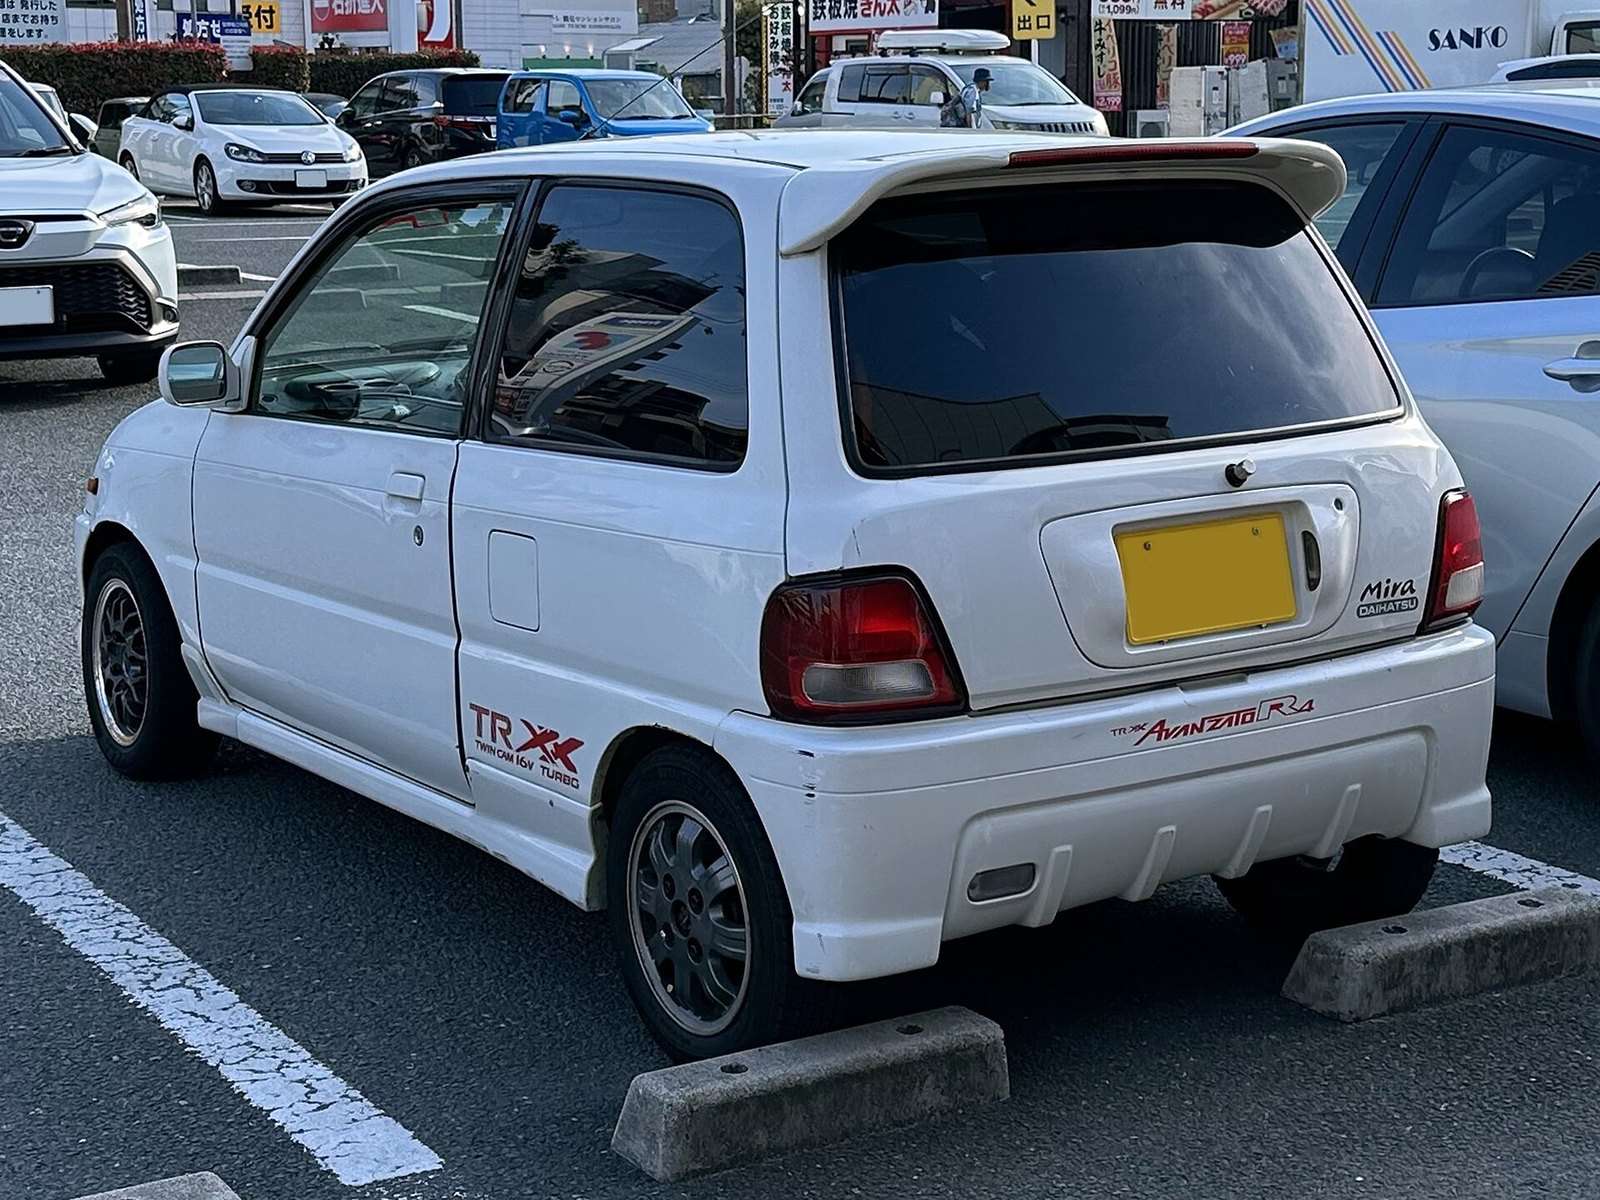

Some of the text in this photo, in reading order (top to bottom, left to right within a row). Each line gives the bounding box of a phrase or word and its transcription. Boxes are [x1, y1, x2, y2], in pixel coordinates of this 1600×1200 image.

[1017, 14, 1051, 31] 出口
[1428, 26, 1508, 51] SANKO
[1360, 578, 1416, 601] Mira
[1359, 598, 1417, 616] DAIHATSU
[474, 739, 497, 757] TWIN
[496, 749, 515, 763] CAM
[540, 765, 580, 790] TURBO
